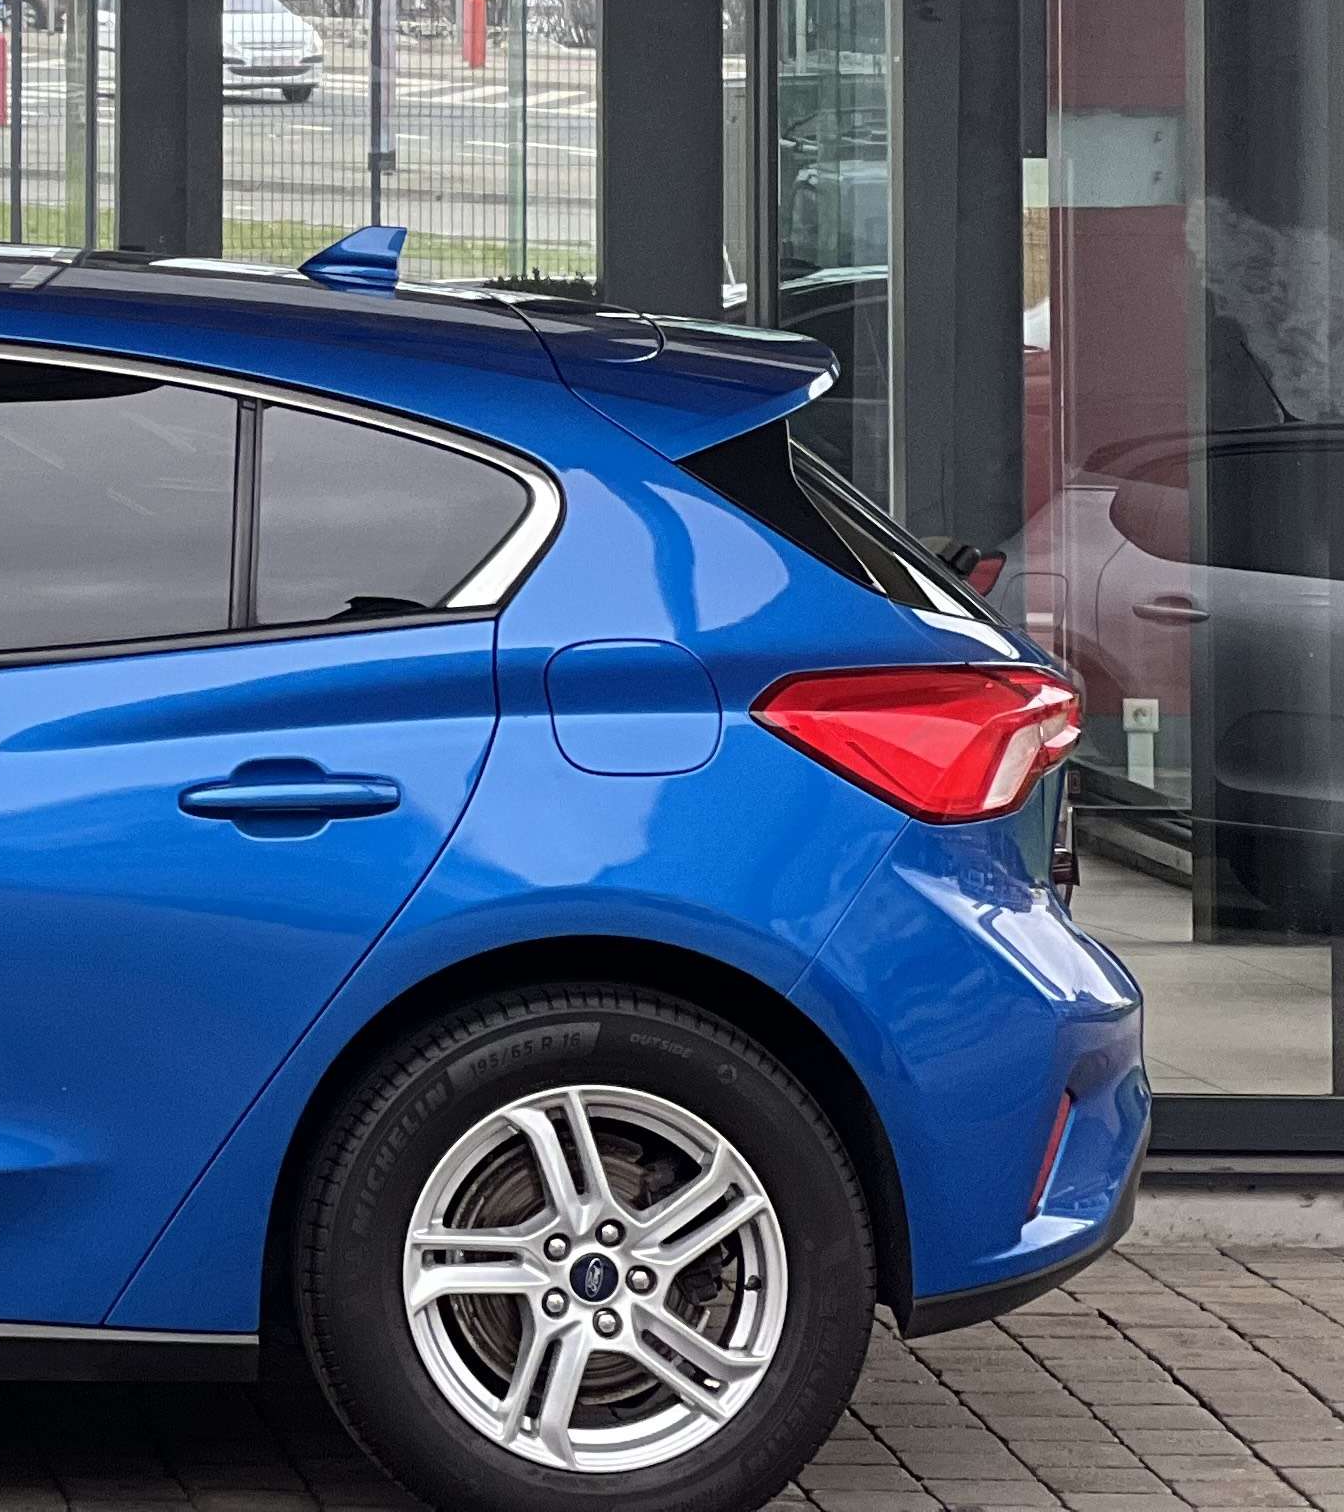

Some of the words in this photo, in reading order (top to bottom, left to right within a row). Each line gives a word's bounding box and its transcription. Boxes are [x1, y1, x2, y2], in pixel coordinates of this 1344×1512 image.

[470, 1040, 534, 1076] 195/65
[541, 1036, 554, 1051] R
[563, 1033, 582, 1047] 16
[629, 1033, 692, 1059] OUTSIDE
[352, 1082, 448, 1235] MICHELIN
